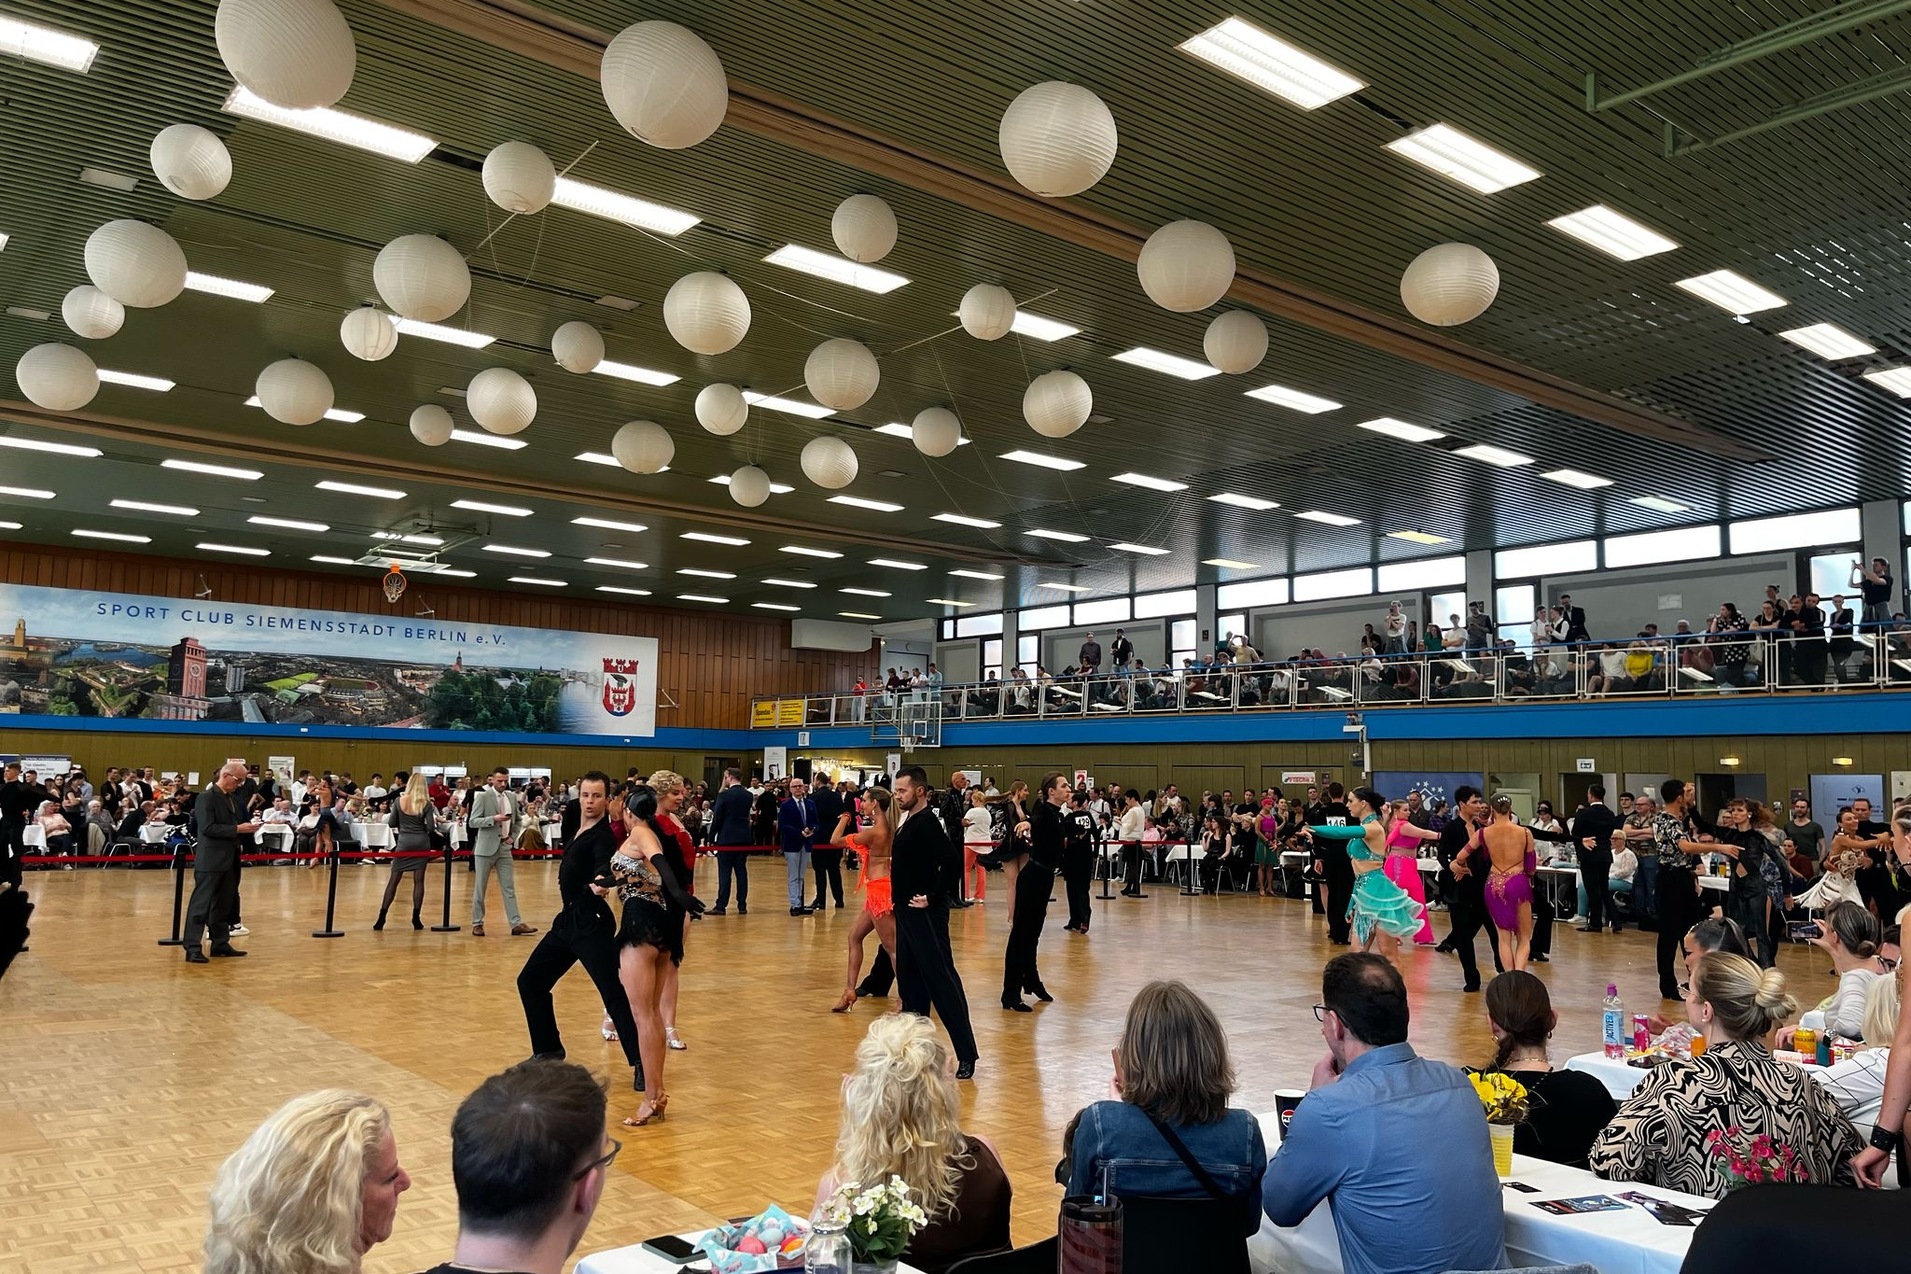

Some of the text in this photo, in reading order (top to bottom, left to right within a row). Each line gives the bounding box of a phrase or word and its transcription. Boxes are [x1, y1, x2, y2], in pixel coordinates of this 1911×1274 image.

[97, 603, 170, 619] SPORT
[181, 609, 234, 625] CLUB
[246, 614, 395, 637] SIEMENSSTADT
[404, 627, 466, 642] BERLIN
